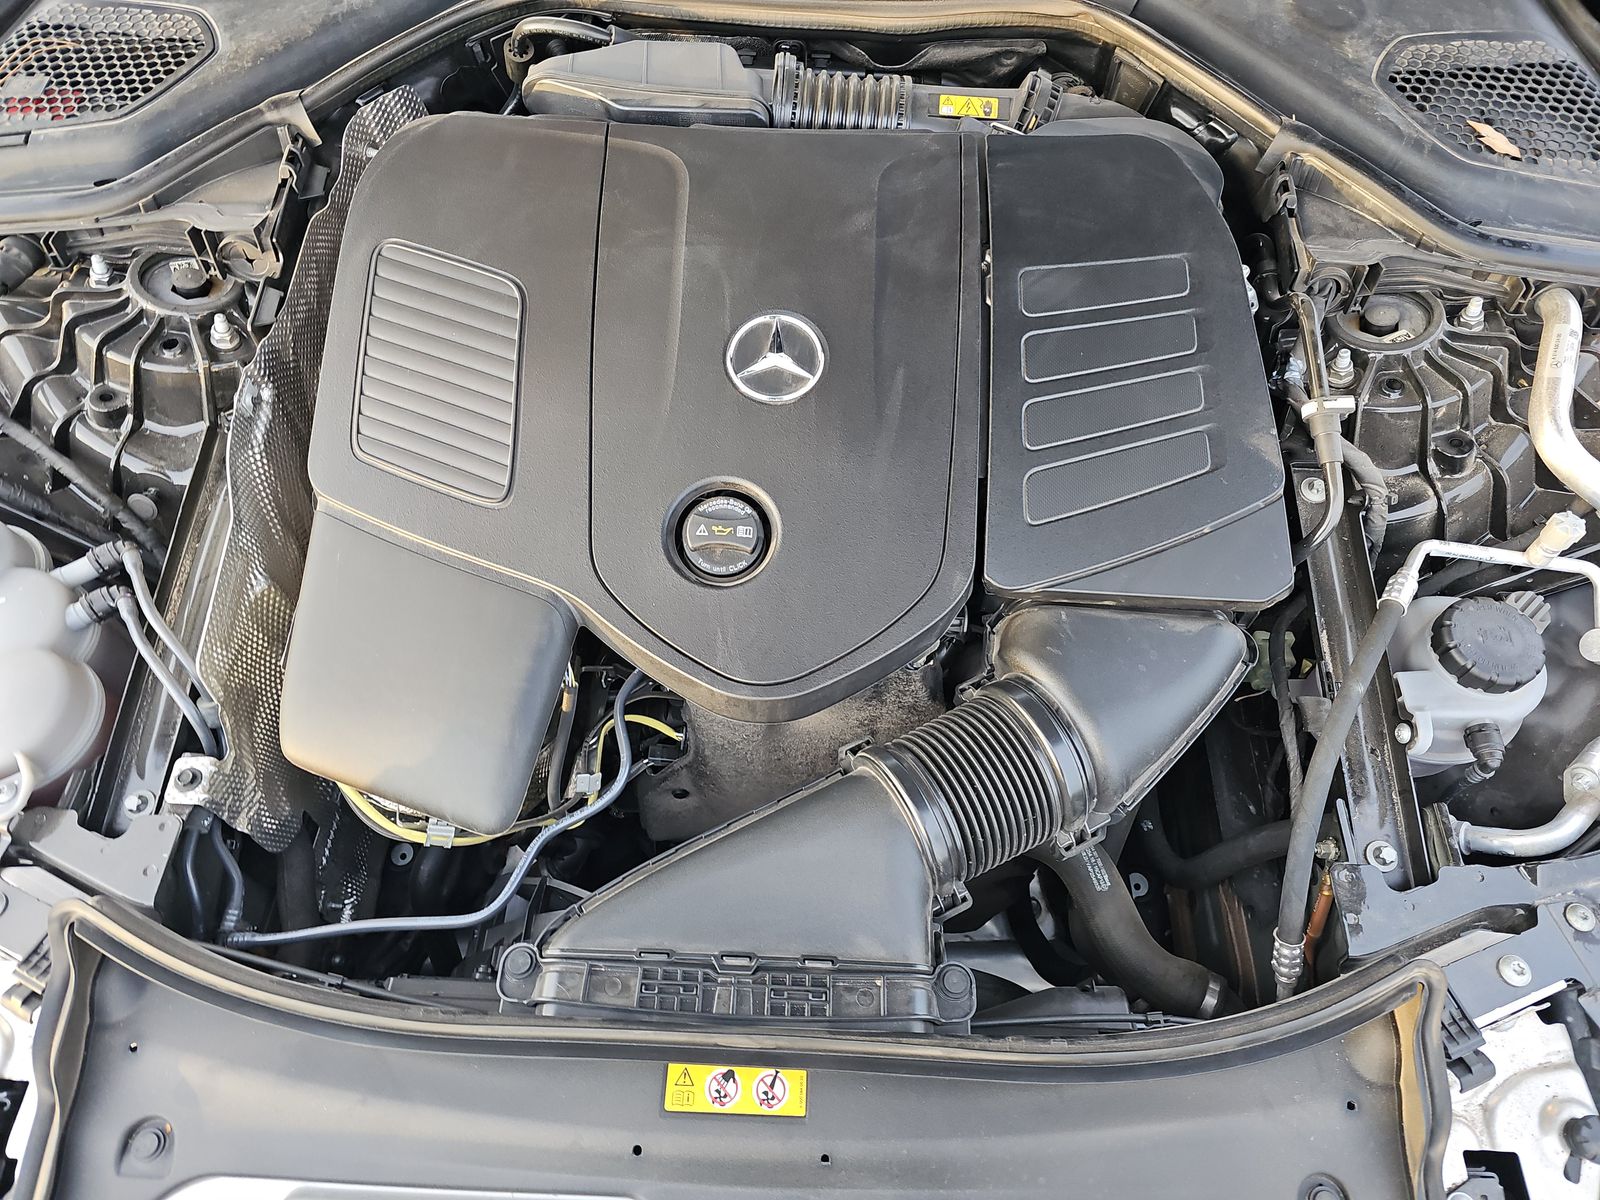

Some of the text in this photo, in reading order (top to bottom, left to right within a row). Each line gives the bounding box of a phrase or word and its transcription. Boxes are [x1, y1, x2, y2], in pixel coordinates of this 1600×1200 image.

[698, 499, 744, 512] Mercedes-Benz
[705, 504, 746, 516] recommended
[697, 558, 711, 570] Turn
[728, 560, 748, 572] CLICK
